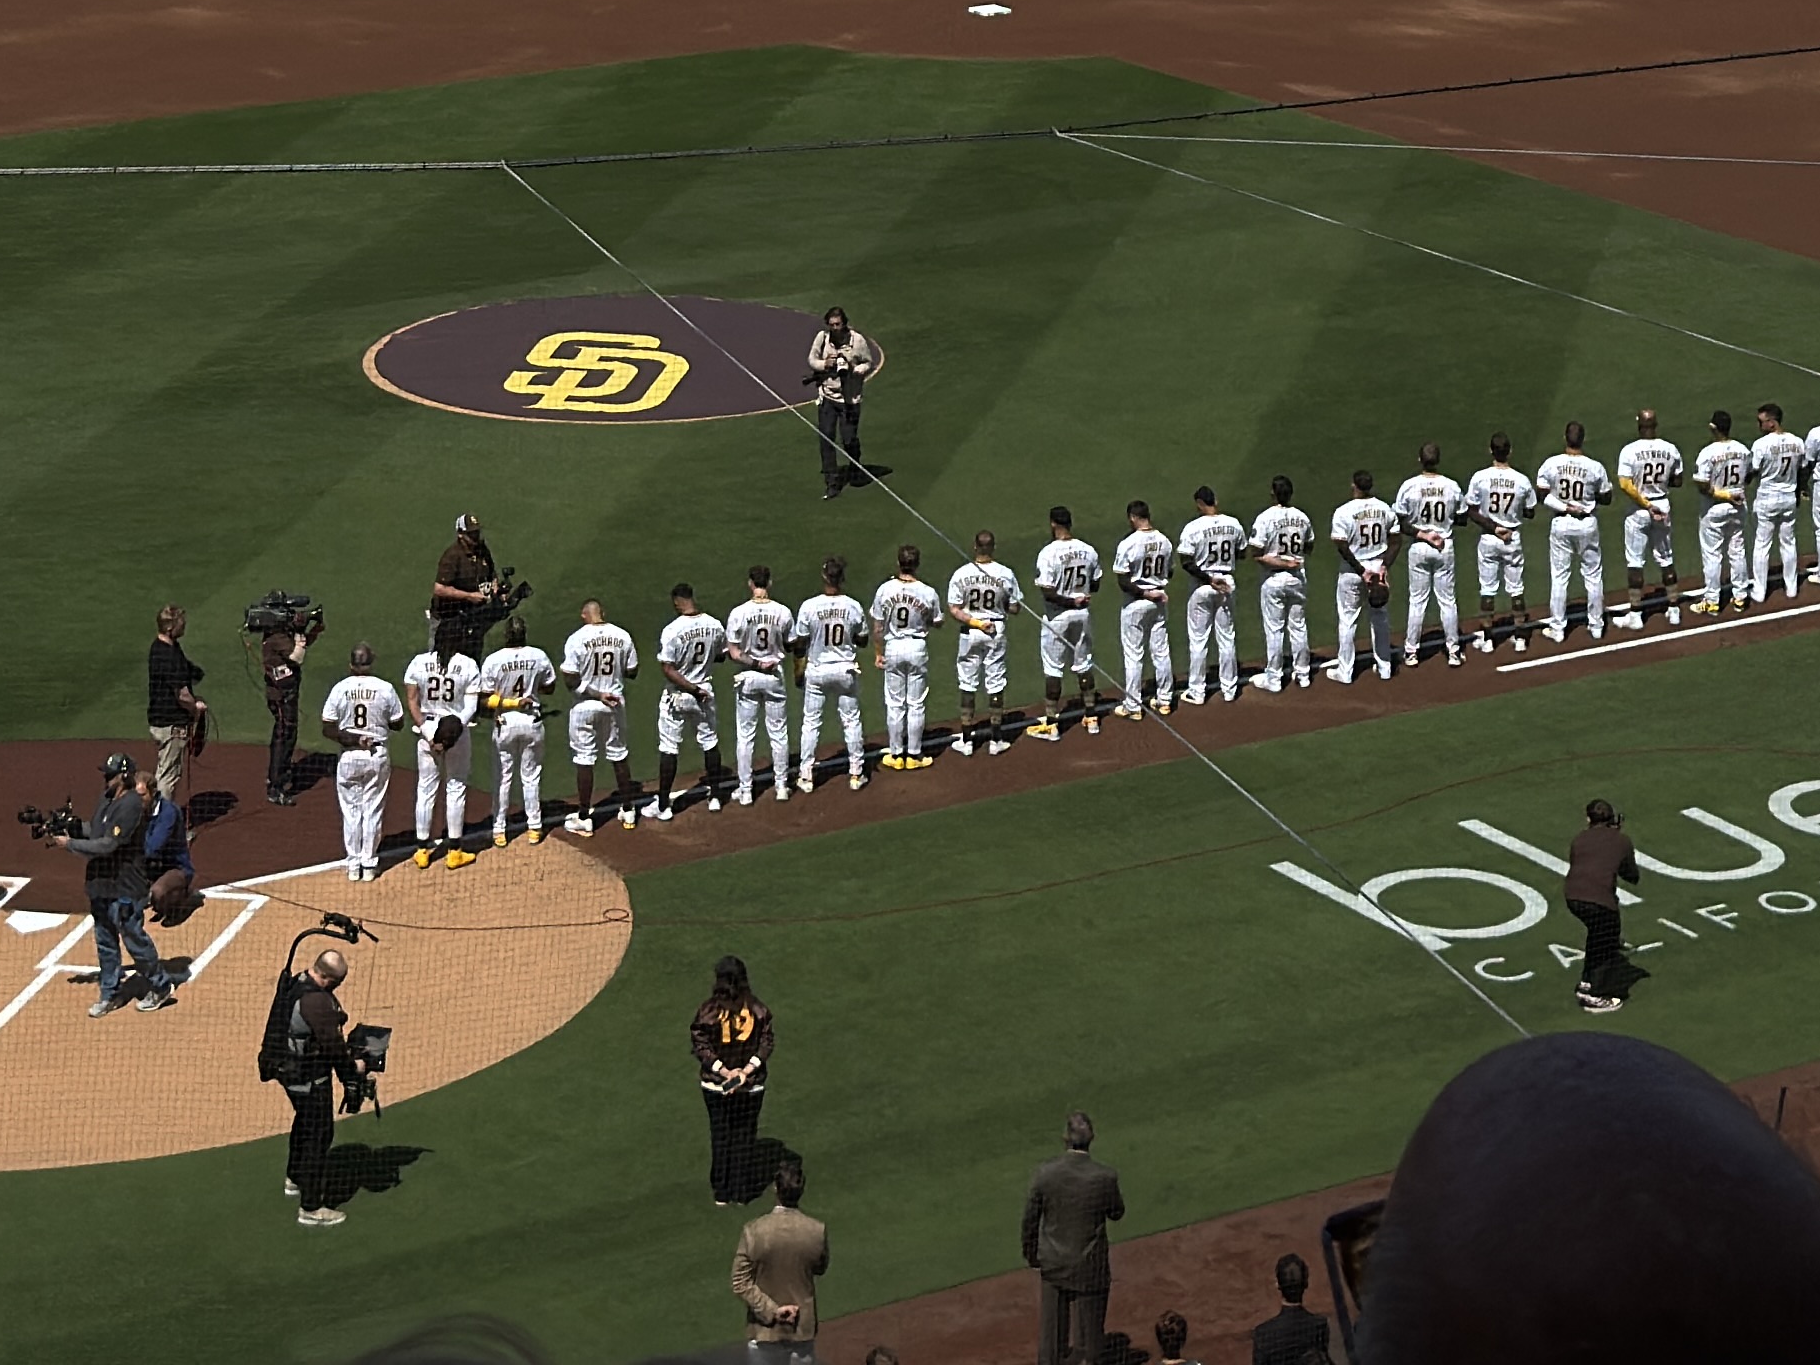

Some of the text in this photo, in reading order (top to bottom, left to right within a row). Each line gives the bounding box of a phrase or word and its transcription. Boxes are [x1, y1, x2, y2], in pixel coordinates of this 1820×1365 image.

[504, 331, 691, 413] SD
[1643, 462, 1665, 484] 22
[1723, 465, 1740, 488] 15
[1781, 456, 1791, 476] 7
[1559, 479, 1583, 501] 30
[1421, 501, 1446, 524] 40
[1489, 491, 1515, 515] 37
[1278, 532, 1301, 556] 56
[1360, 522, 1382, 547] 50
[1208, 540, 1231, 564] 58
[1063, 565, 1087, 591] 75
[1142, 556, 1164, 579] 60
[968, 589, 996, 611] 28
[896, 606, 909, 629] 9
[756, 628, 769, 651] 3
[824, 623, 844, 647] 10
[593, 651, 615, 676] 13
[694, 641, 706, 665] 2
[427, 676, 455, 703] 23
[512, 674, 525, 697] 4
[353, 703, 368, 729] 8
[717, 1003, 755, 1044] 19
